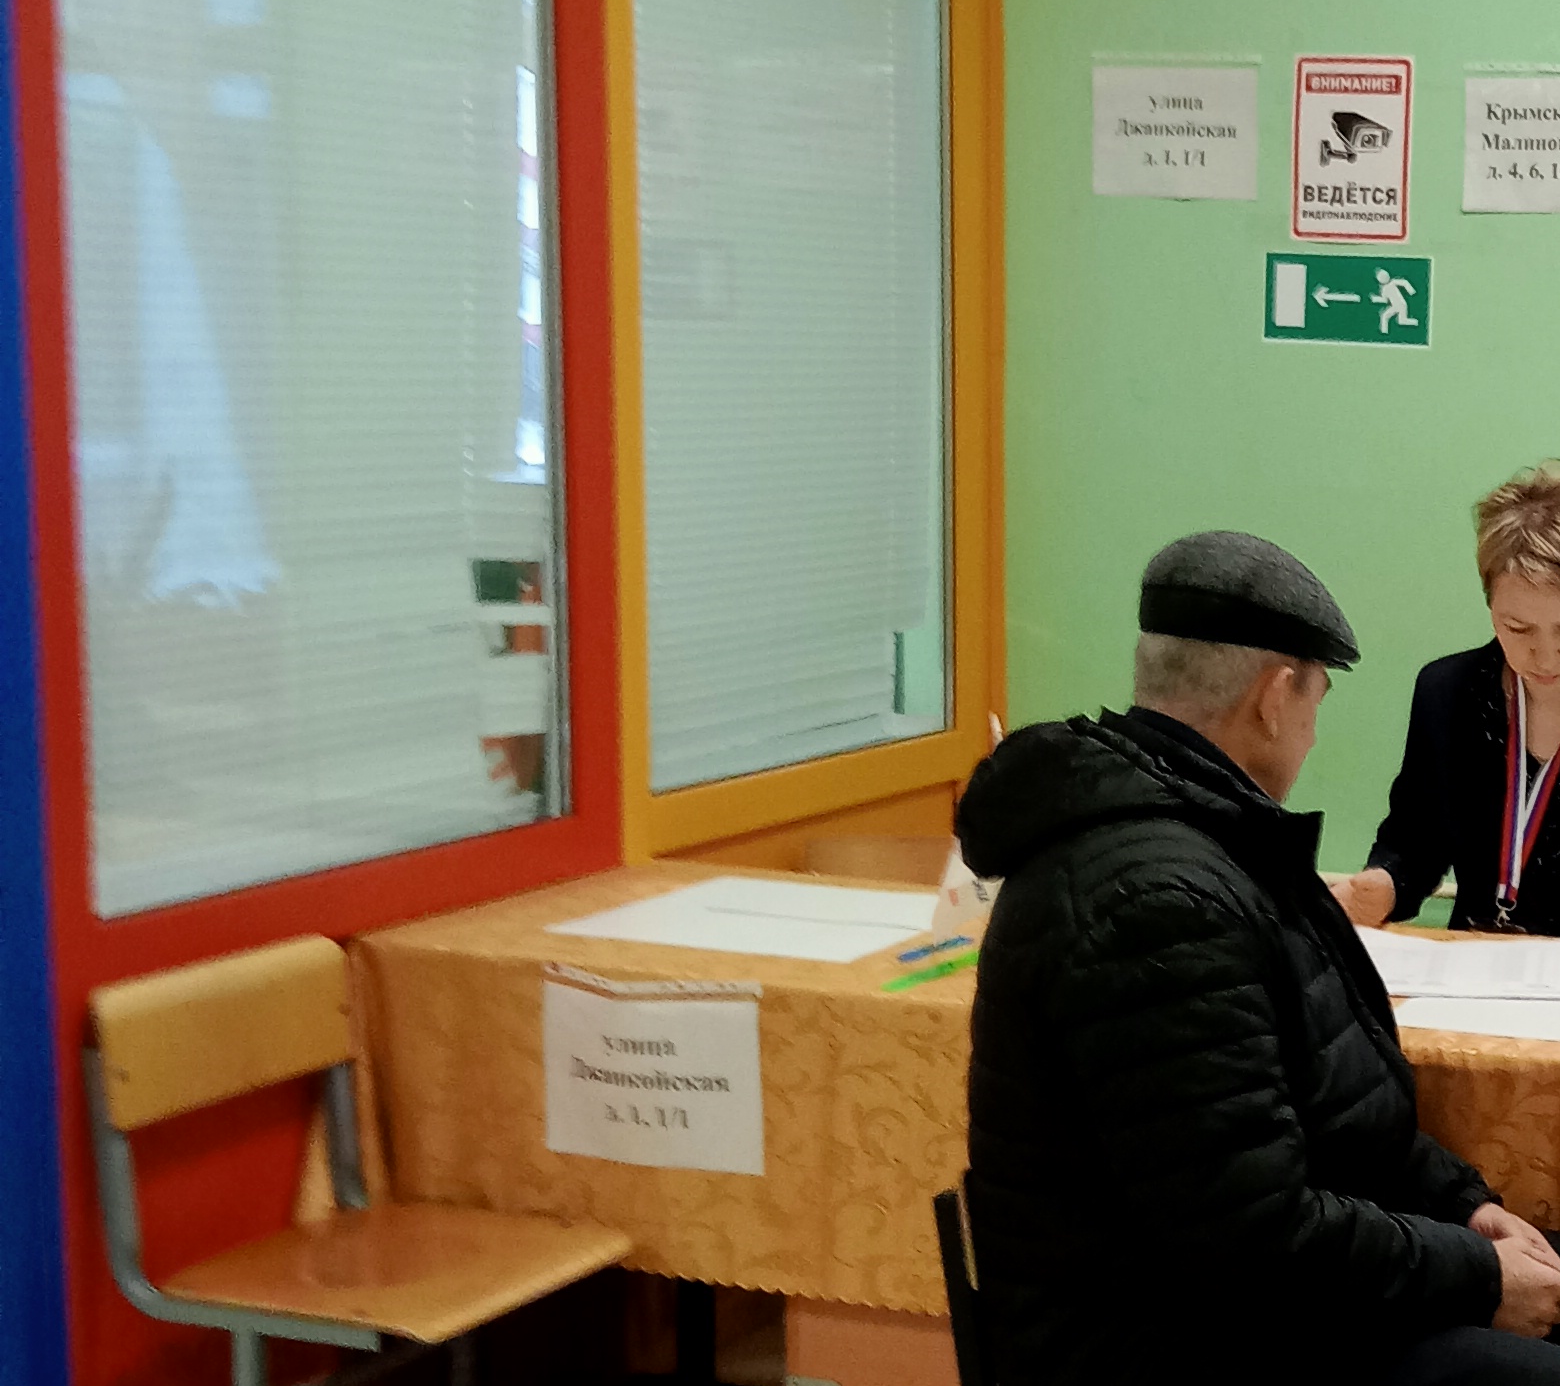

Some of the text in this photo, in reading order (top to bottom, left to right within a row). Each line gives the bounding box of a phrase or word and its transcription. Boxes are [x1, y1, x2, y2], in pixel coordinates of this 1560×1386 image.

[1310, 76, 1397, 92] ВНИМАНИЕ!
[1149, 95, 1204, 113] улица
[1487, 166, 1503, 181] д.
[1508, 162, 1524, 180] 4,
[1529, 163, 1545, 181] 6,
[1303, 180, 1398, 208] ВЕДЁТСЯ
